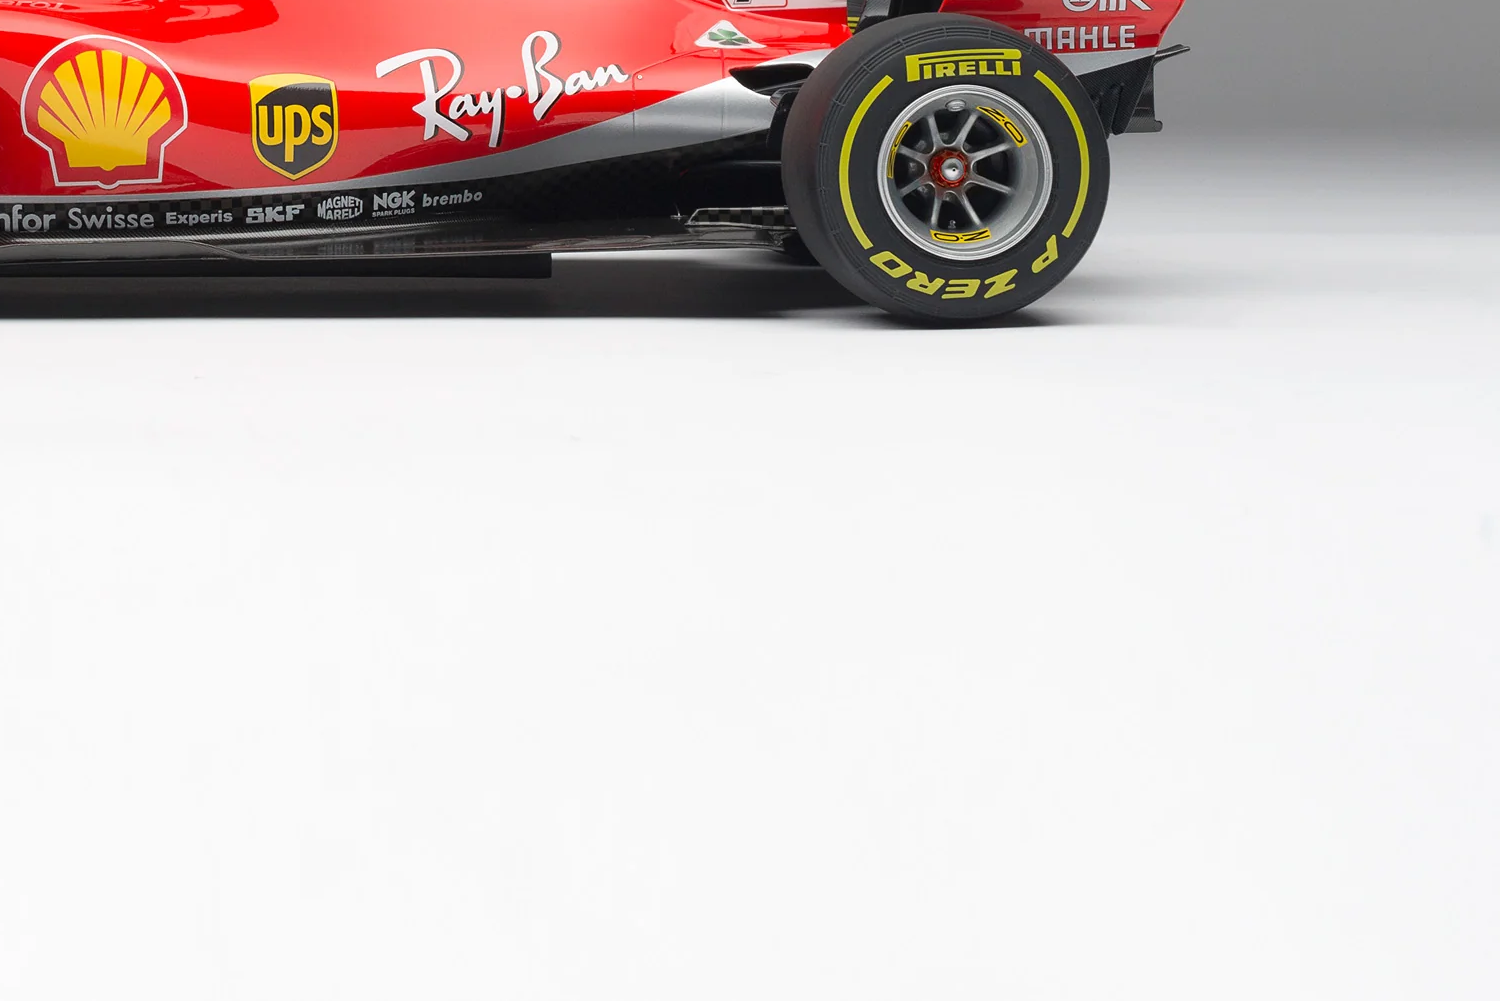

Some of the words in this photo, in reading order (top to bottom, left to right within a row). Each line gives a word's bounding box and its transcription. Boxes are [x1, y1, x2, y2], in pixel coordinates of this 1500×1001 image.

[1024, 25, 1136, 50] MAHLE
[905, 48, 1022, 82] PIRELLI
[258, 104, 332, 162] ups
[317, 195, 363, 212] MAGNETI
[373, 190, 416, 210] NGK
[422, 189, 483, 208] brembo
[68, 206, 155, 229] Swisse
[166, 210, 233, 226] Experis
[245, 204, 305, 224] SKF
[1031, 234, 1059, 274] P
[869, 250, 1018, 299] ZERO
